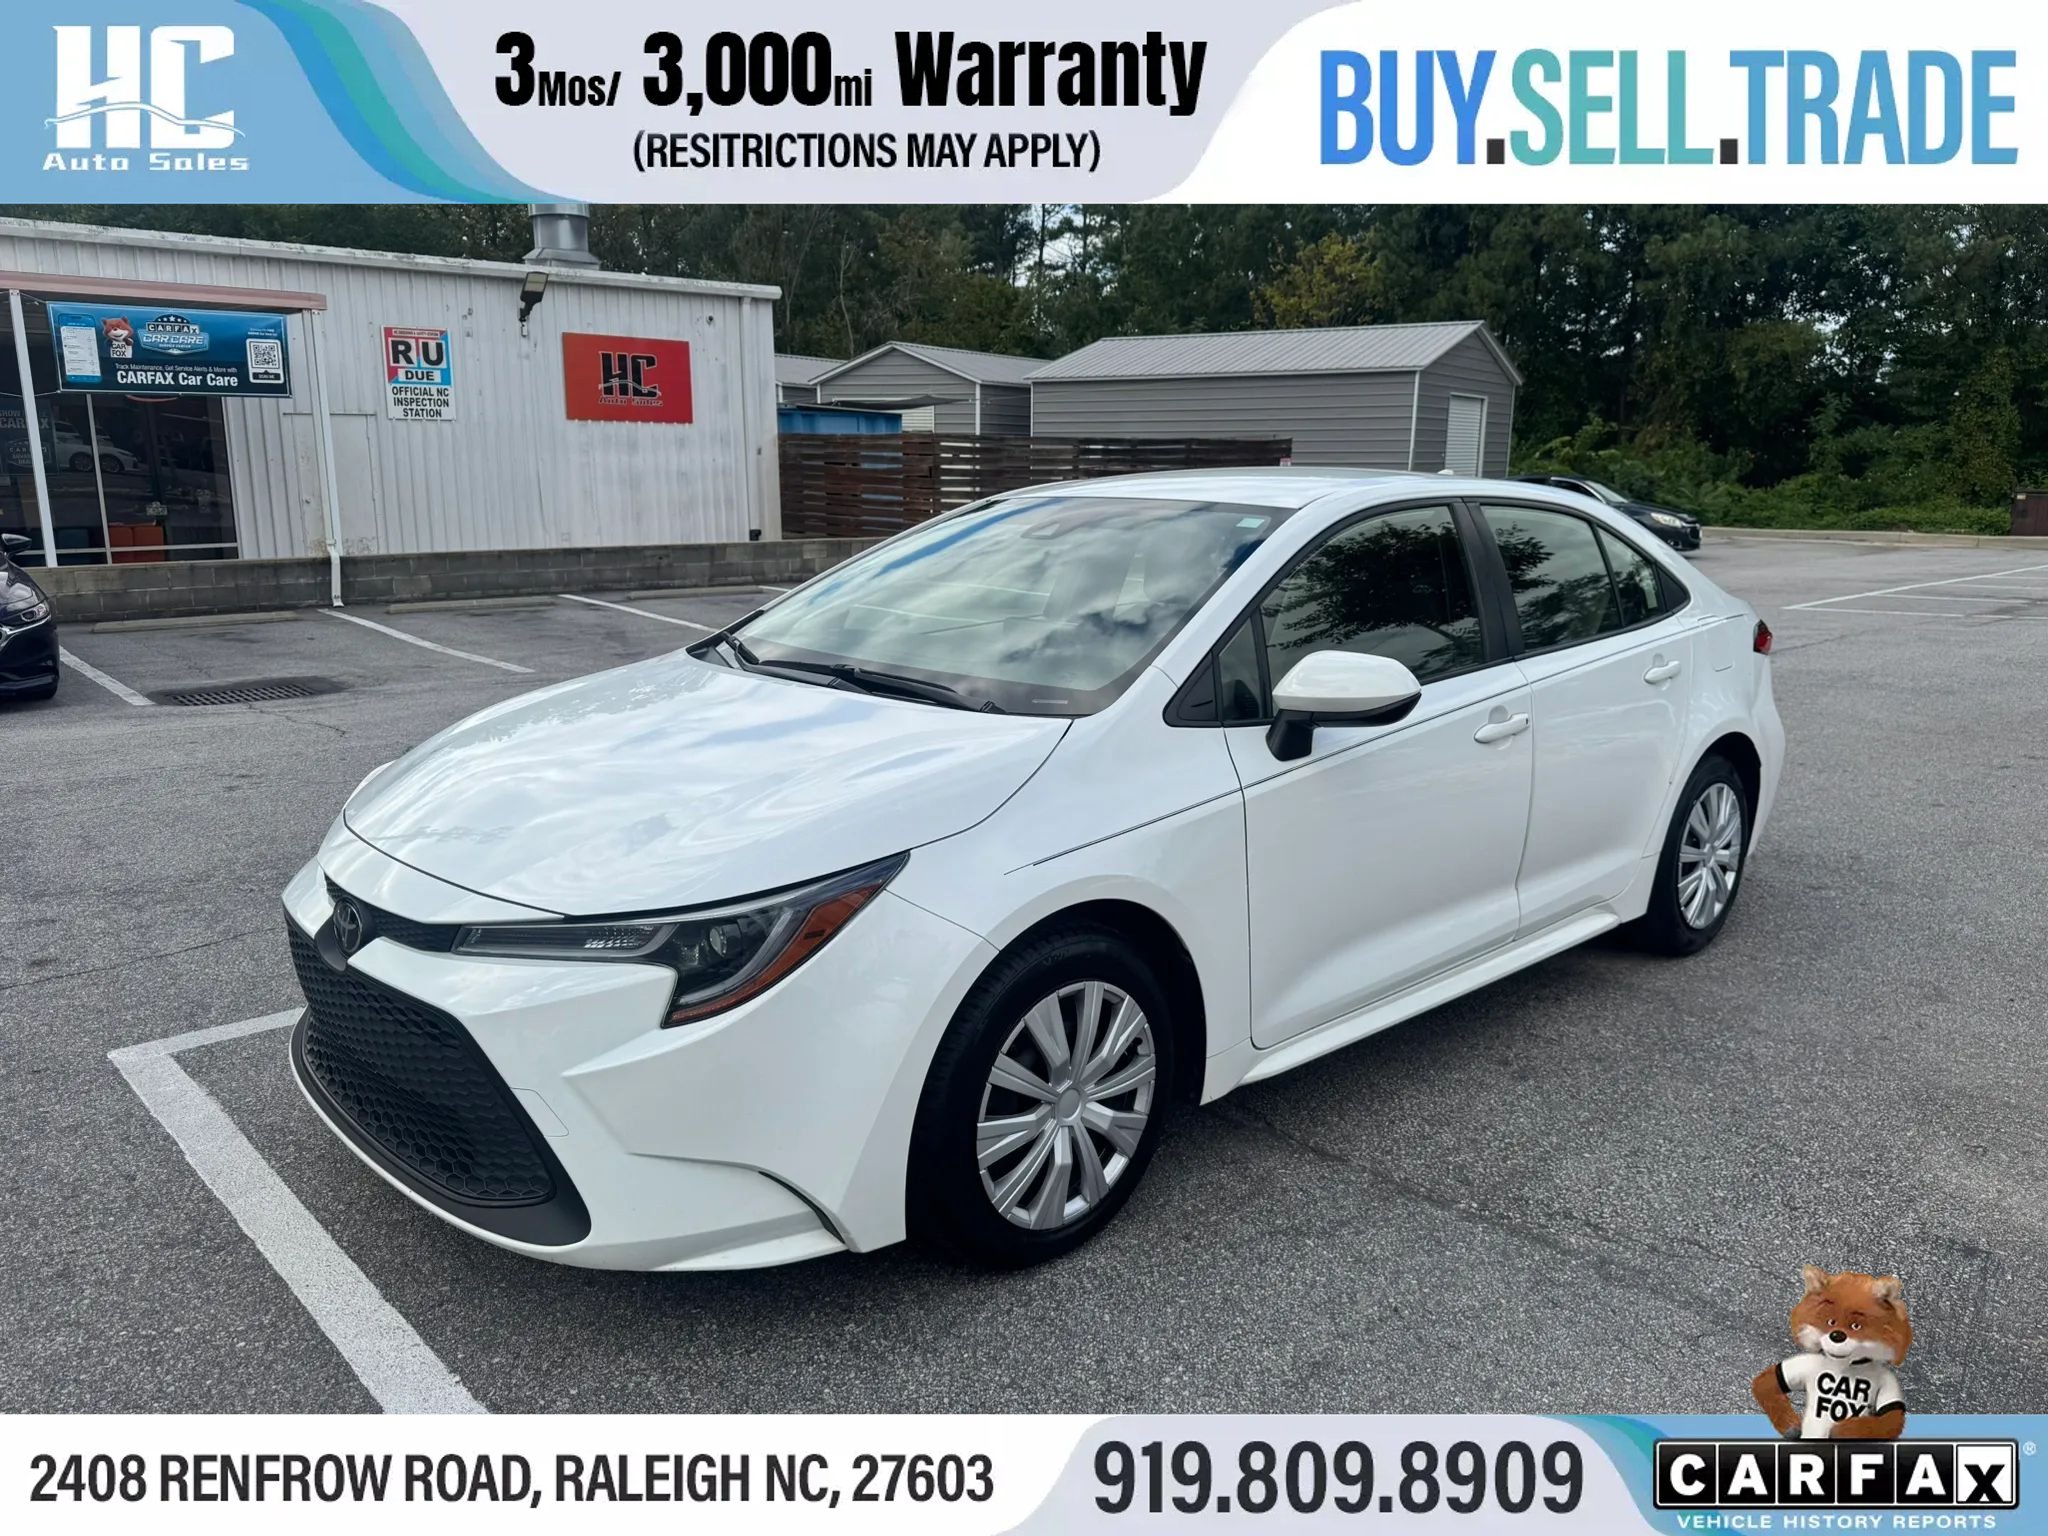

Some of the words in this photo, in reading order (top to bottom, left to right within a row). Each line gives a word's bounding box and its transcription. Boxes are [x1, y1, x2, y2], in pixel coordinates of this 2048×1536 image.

[148, 323, 199, 334] CARFAX
[143, 333, 169, 343] CAR
[170, 335, 204, 344] CARE
[116, 370, 175, 385] CARFAX
[178, 372, 203, 386] Car
[206, 373, 238, 387] Care
[405, 370, 435, 381] DUE
[599, 351, 658, 399] HC
[391, 386, 434, 397] OFFICIAL
[436, 388, 449, 397] NC
[393, 397, 449, 408] INSPECTION
[402, 408, 442, 418] STATION
[0, 417, 49, 429] CARX
